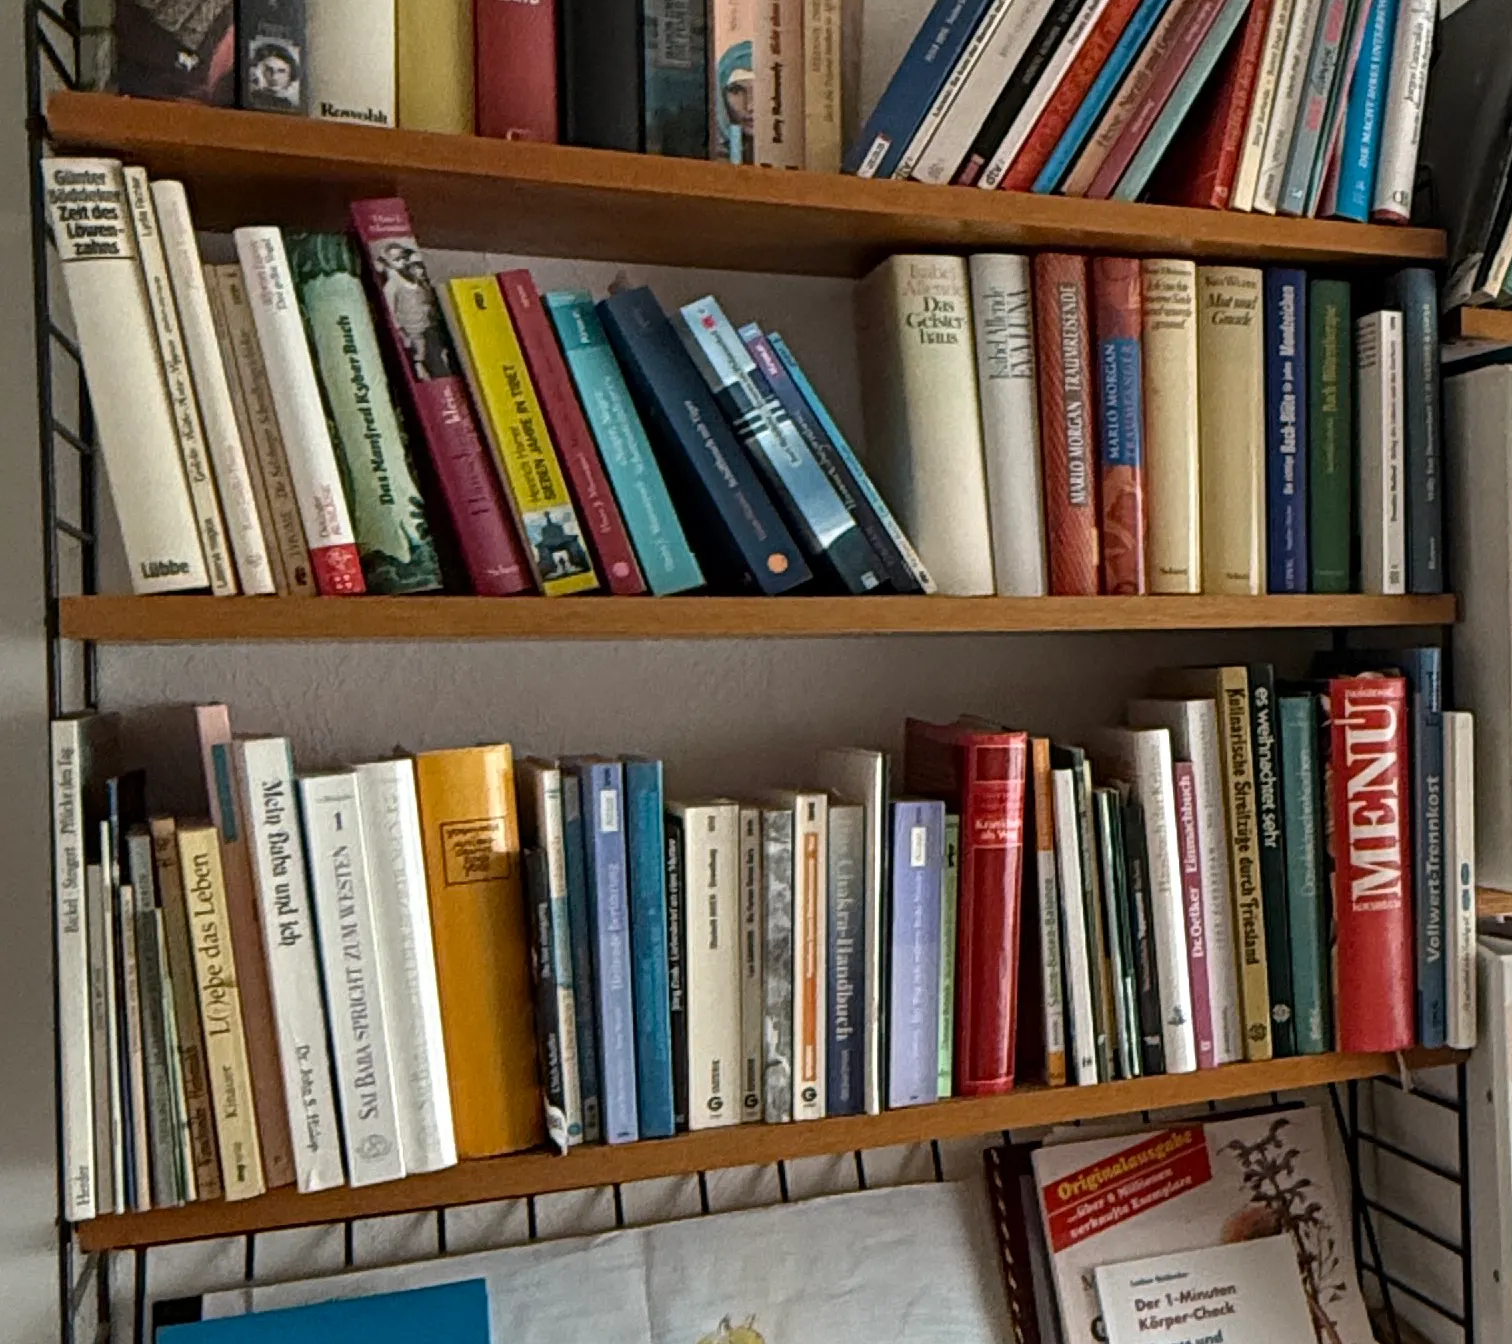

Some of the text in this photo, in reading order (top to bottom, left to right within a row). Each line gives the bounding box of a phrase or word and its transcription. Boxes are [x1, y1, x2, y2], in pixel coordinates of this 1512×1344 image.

[1357, 97, 1376, 143] MACHT
[57, 204, 118, 222] Zeit des
[919, 328, 958, 344] haus
[923, 296, 955, 312] Das
[982, 284, 1009, 381] Isabel Allende
[335, 312, 395, 507] Das Manfred Kyber Buch
[1057, 283, 1085, 504] MARLO MORGAN TRAUMREISENDE
[1104, 343, 1119, 459] MARLO MORGAN
[501, 362, 556, 502] SIEBEN JAHRE IN TIBET
[1223, 686, 1251, 777] Kulinarische
[261, 775, 288, 826] Mein
[1255, 687, 1283, 848] es weihnachtet sehr
[1328, 698, 1402, 903] MENÜ
[1176, 774, 1196, 874] Einmachbuch
[1229, 779, 1255, 853] Streifzüge
[190, 851, 214, 919] Leben
[272, 828, 296, 877] Baba
[330, 842, 356, 919] WESTEN
[1238, 855, 1257, 898] durch
[1420, 773, 1445, 962] Vollwert-Trennkost
[275, 880, 298, 918] und
[197, 920, 219, 960] das
[338, 920, 361, 962] ZUM
[830, 856, 858, 1042] Chakra-Handbuch
[343, 965, 369, 1042] SPRICHT
[347, 1042, 374, 1089] BABA
[74, 1163, 91, 1207] Herder
[1057, 1130, 1193, 1199] Originalausgabe
[1116, 1166, 1174, 1198] Millionen
[1067, 1174, 1195, 1239] verkaufte Exemplare
[1133, 1281, 1237, 1312] Der 1-Minuten
[1137, 1301, 1236, 1333] Körper-Check
